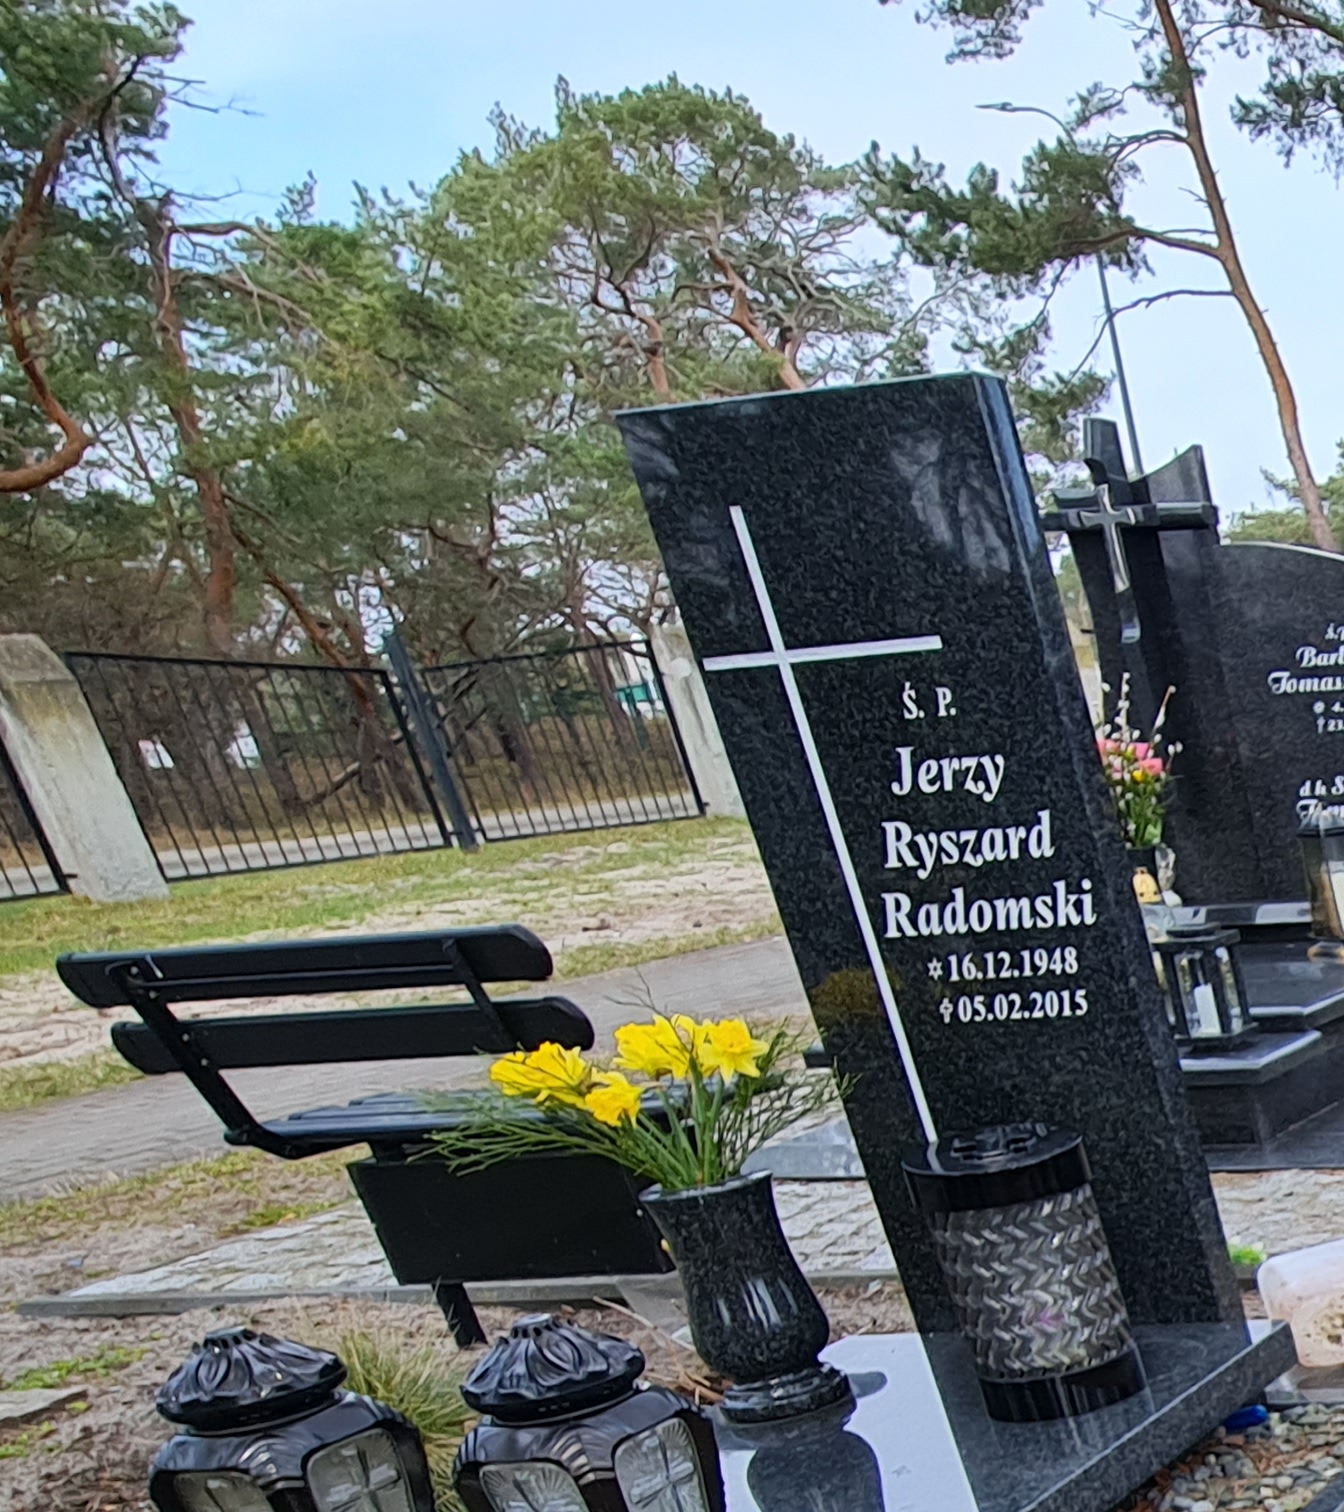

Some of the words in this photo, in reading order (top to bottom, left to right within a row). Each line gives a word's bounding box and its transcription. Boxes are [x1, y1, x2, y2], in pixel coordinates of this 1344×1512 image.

[901, 681, 925, 719] Ś.
[935, 686, 957, 717] P.
[891, 746, 1005, 803] Jerzy
[880, 808, 1056, 881] Ryszard
[880, 877, 1098, 939] Radomski
[947, 946, 1079, 982] 16.12.1948
[957, 988, 1088, 1023] 05.02.2015
